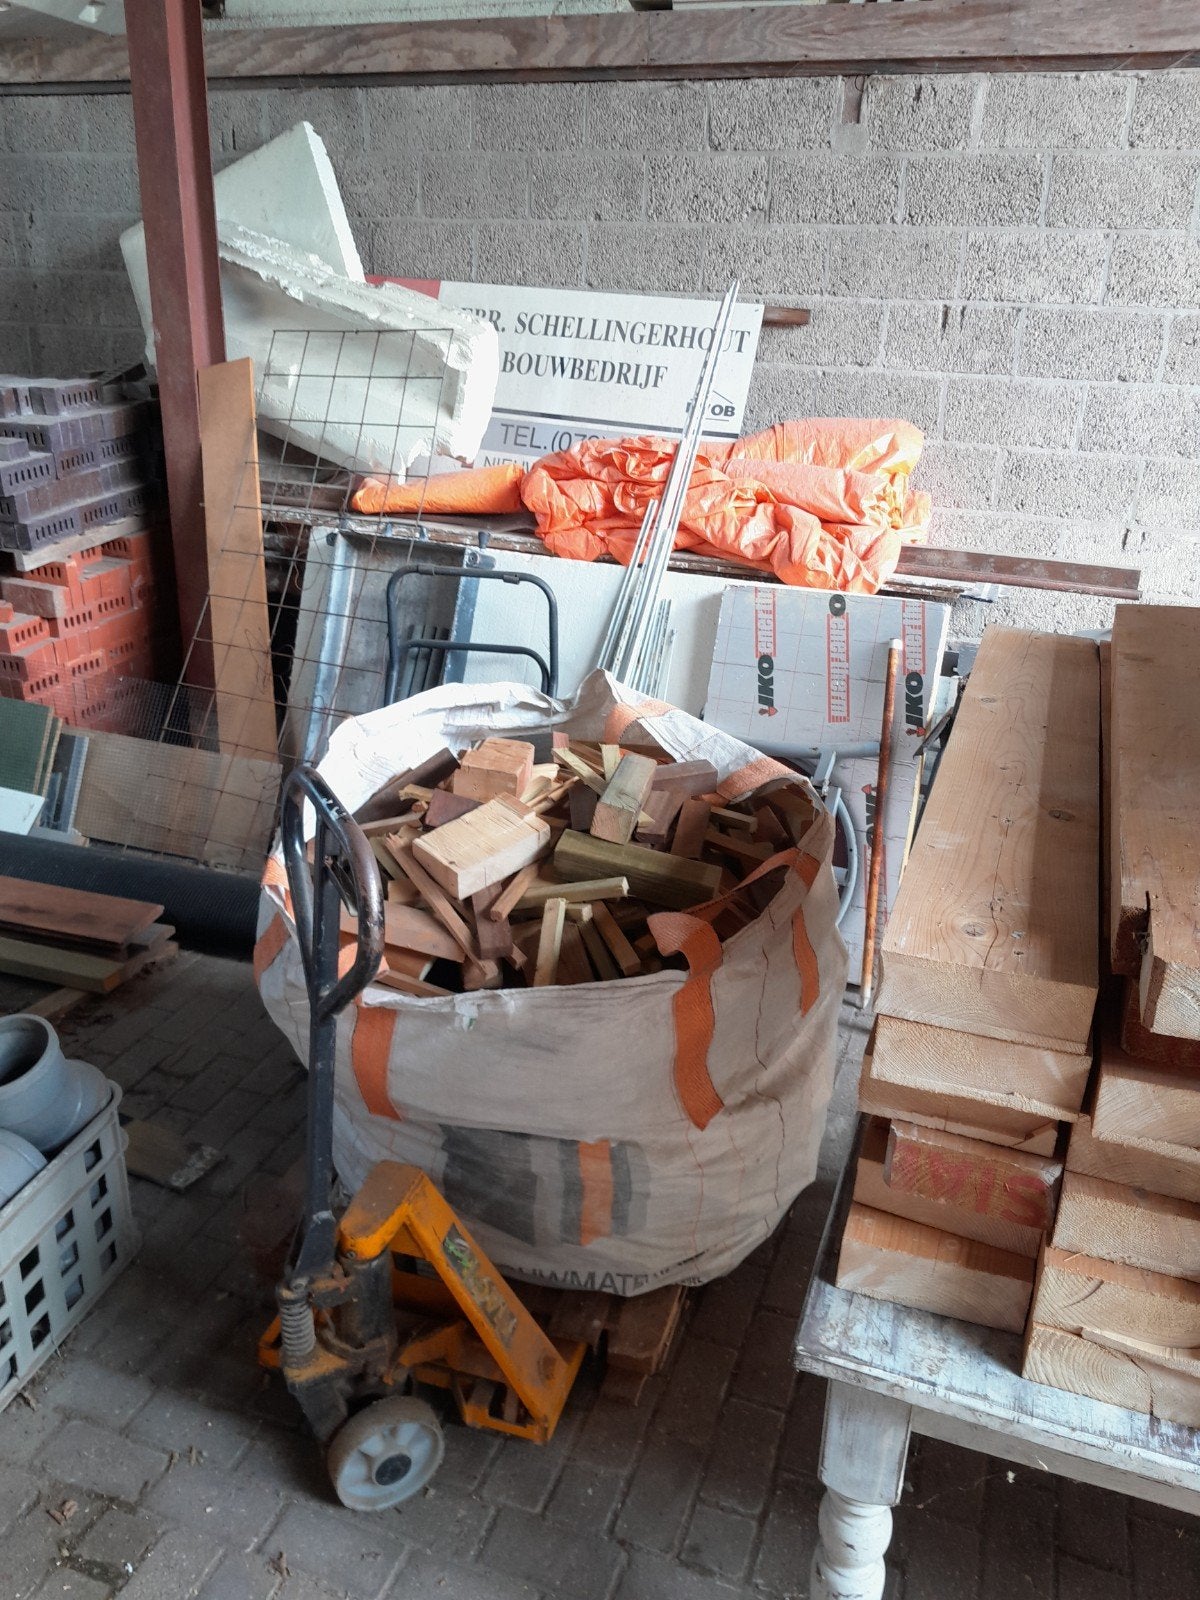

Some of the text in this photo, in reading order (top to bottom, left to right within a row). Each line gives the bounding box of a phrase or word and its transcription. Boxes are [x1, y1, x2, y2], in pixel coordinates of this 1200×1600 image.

[501, 351, 668, 389] BOUWBEDRIJF
[758, 654, 774, 707] IKO
[905, 672, 923, 727] IKO
